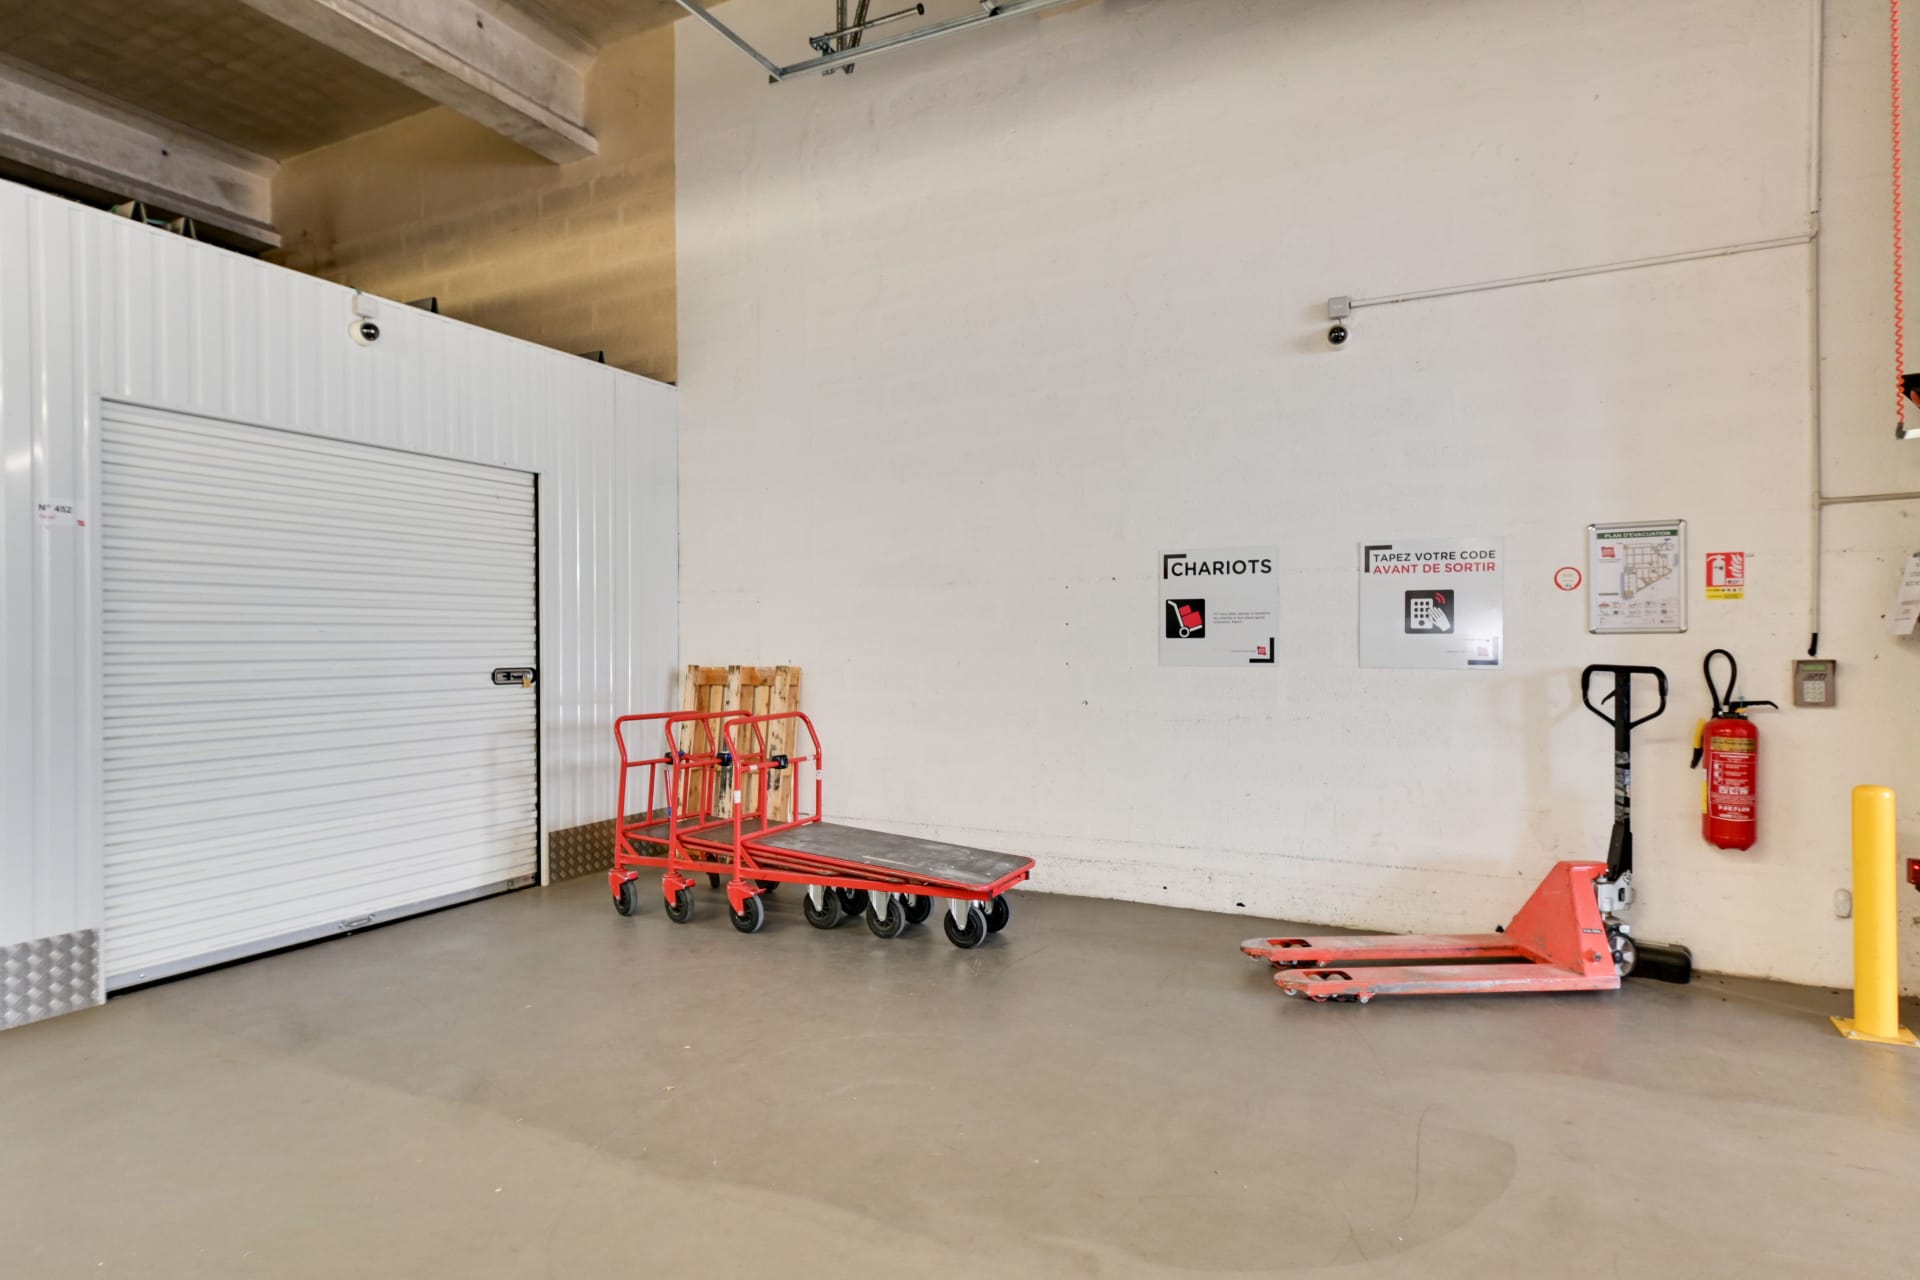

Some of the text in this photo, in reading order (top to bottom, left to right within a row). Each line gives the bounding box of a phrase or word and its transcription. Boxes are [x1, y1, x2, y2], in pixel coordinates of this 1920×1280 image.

[54, 505, 72, 513] 452
[1373, 550, 1496, 562] TAPEZ VOTRE CODE
[1171, 559, 1272, 577] CHARIOTS
[1373, 562, 1496, 574] AVANT DE SORTIR
